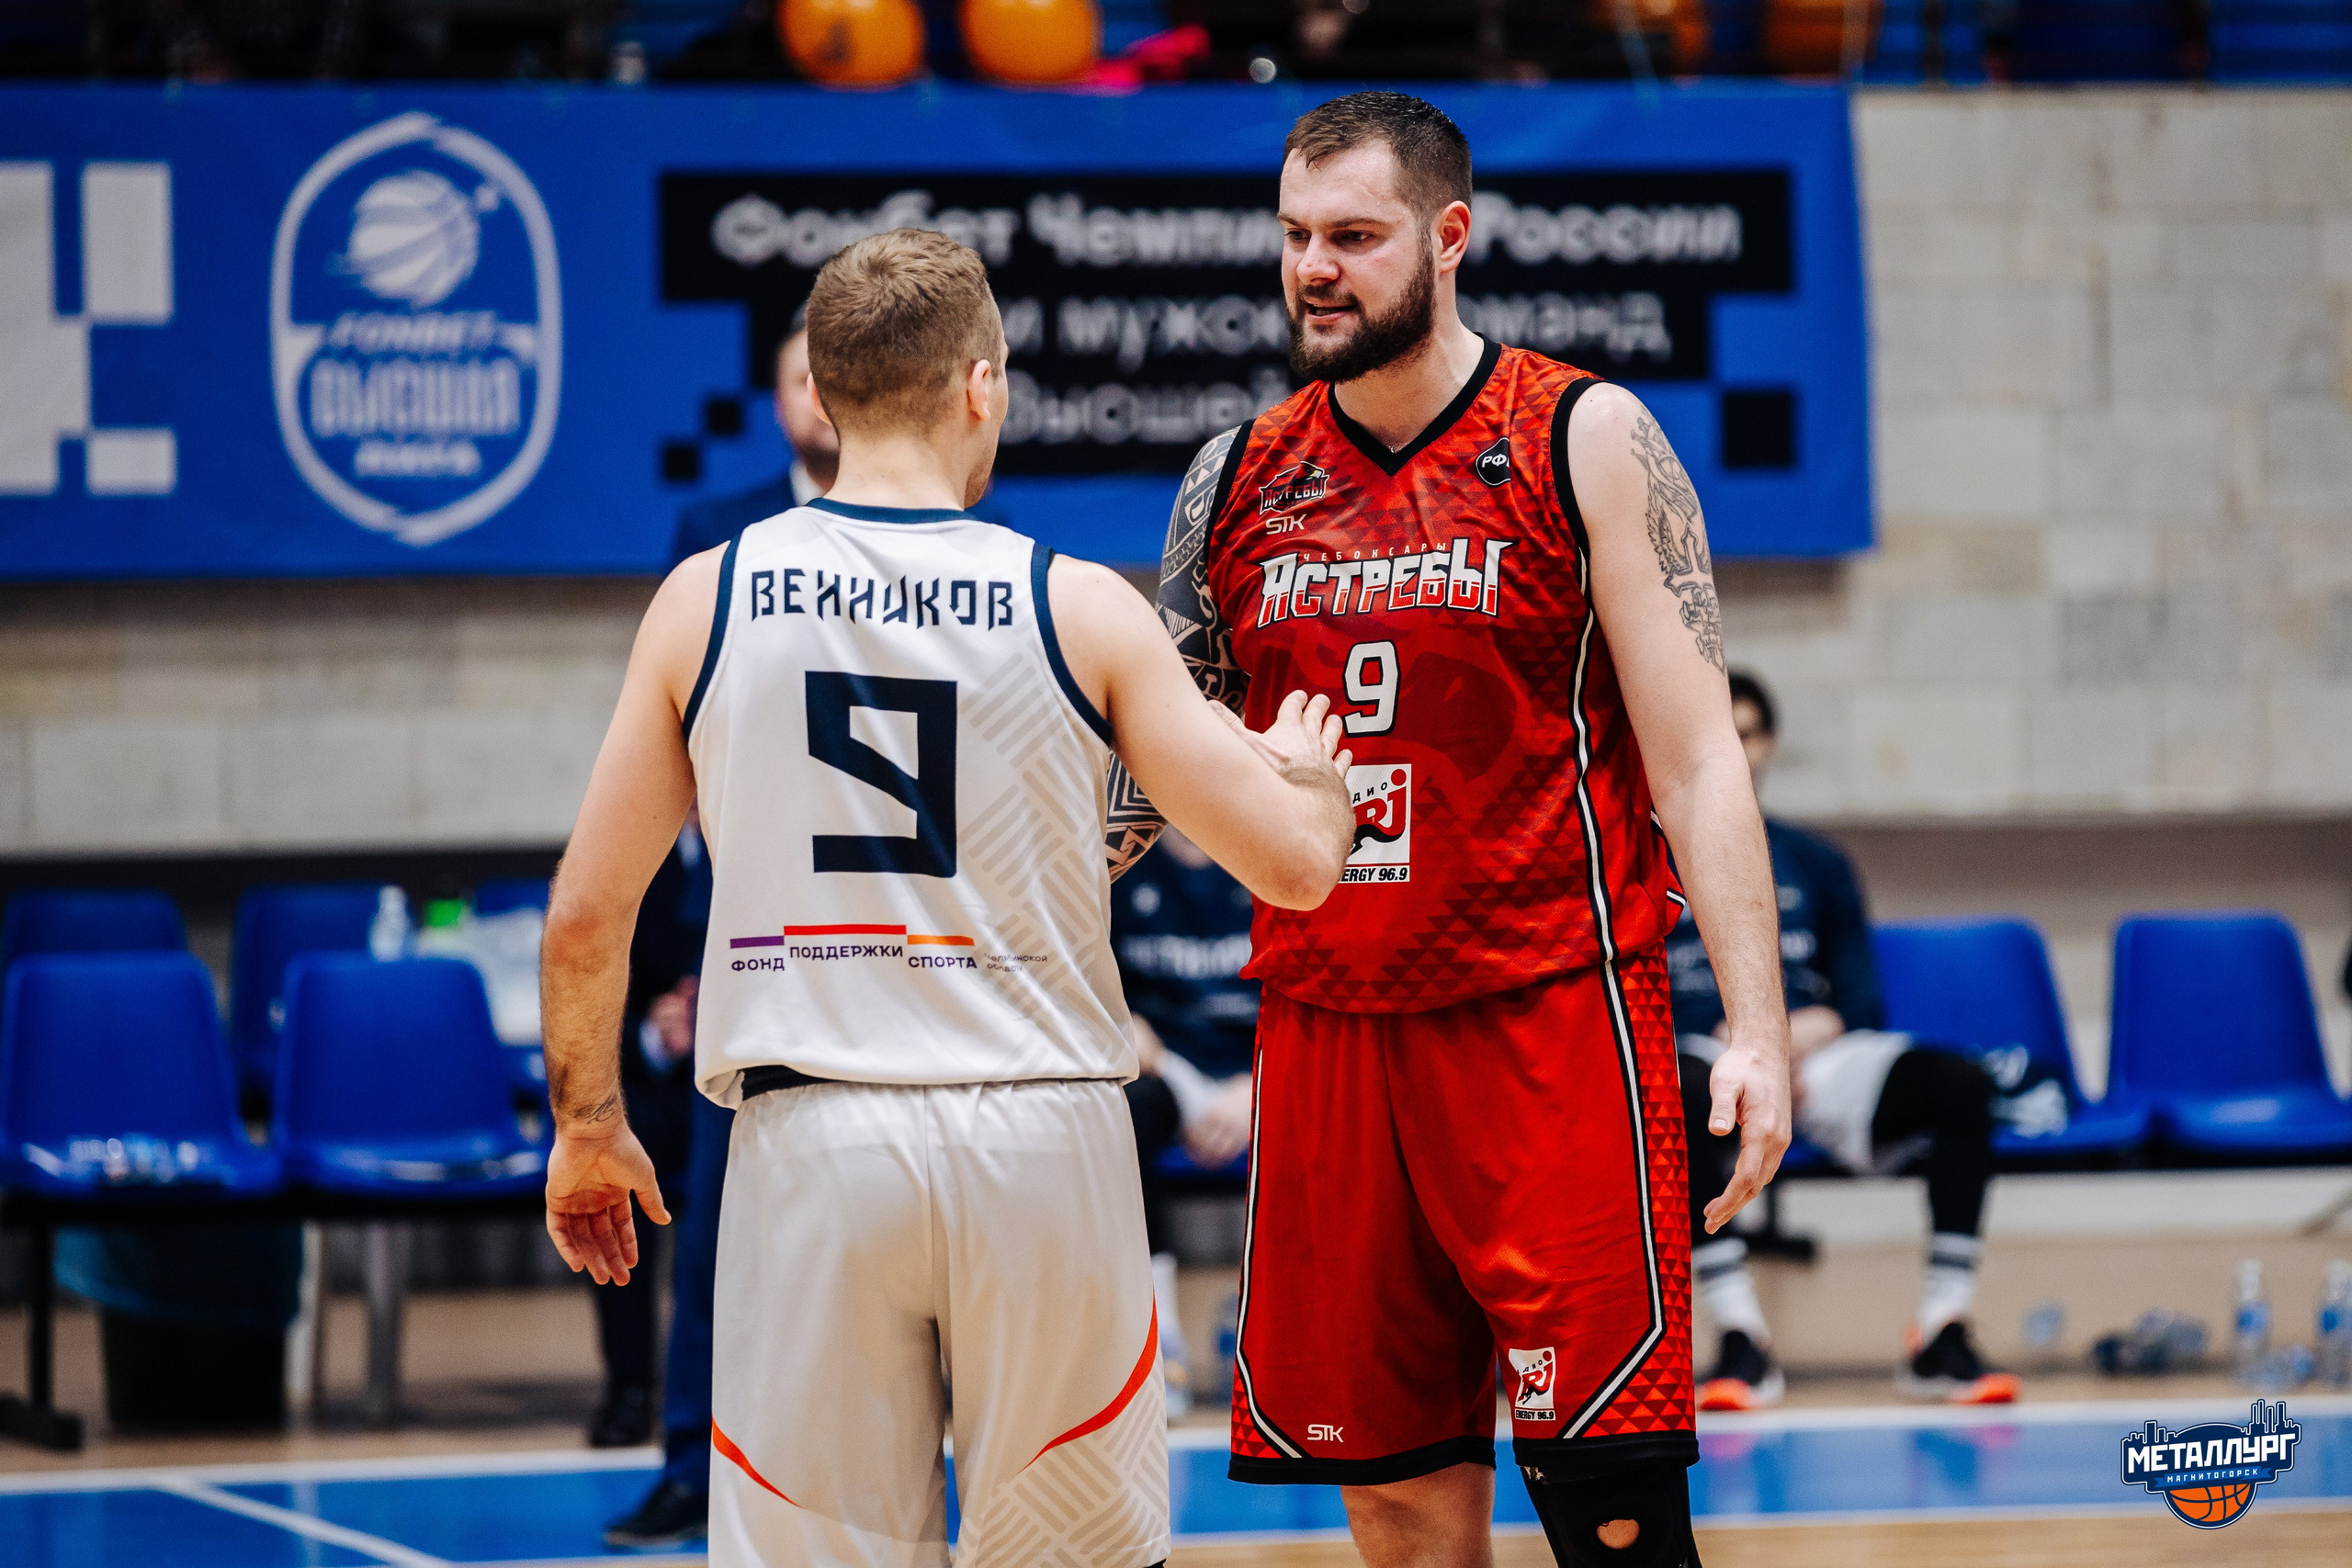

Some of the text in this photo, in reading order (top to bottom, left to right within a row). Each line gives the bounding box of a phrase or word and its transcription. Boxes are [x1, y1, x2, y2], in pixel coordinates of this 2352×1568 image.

[1027, 195, 1283, 266] Чемпи
[1266, 513, 1306, 535] STK
[1304, 542, 1446, 562] ЧЕБОКСАРЫ
[1256, 537, 1518, 629] ЯСТРЕБЫ
[751, 568, 1012, 631] ВЕННИКОВ
[1343, 641, 1400, 737] 9
[805, 671, 957, 878] 9
[1352, 782, 1388, 804] ДИО
[1341, 867, 1408, 882] ERGY 96.9
[731, 944, 978, 972] ФОНД ПОДДЕРЖКИ СПОРТА
[1515, 1409, 1555, 1420] ENERGY 96.9
[1307, 1424, 1344, 1443] STK
